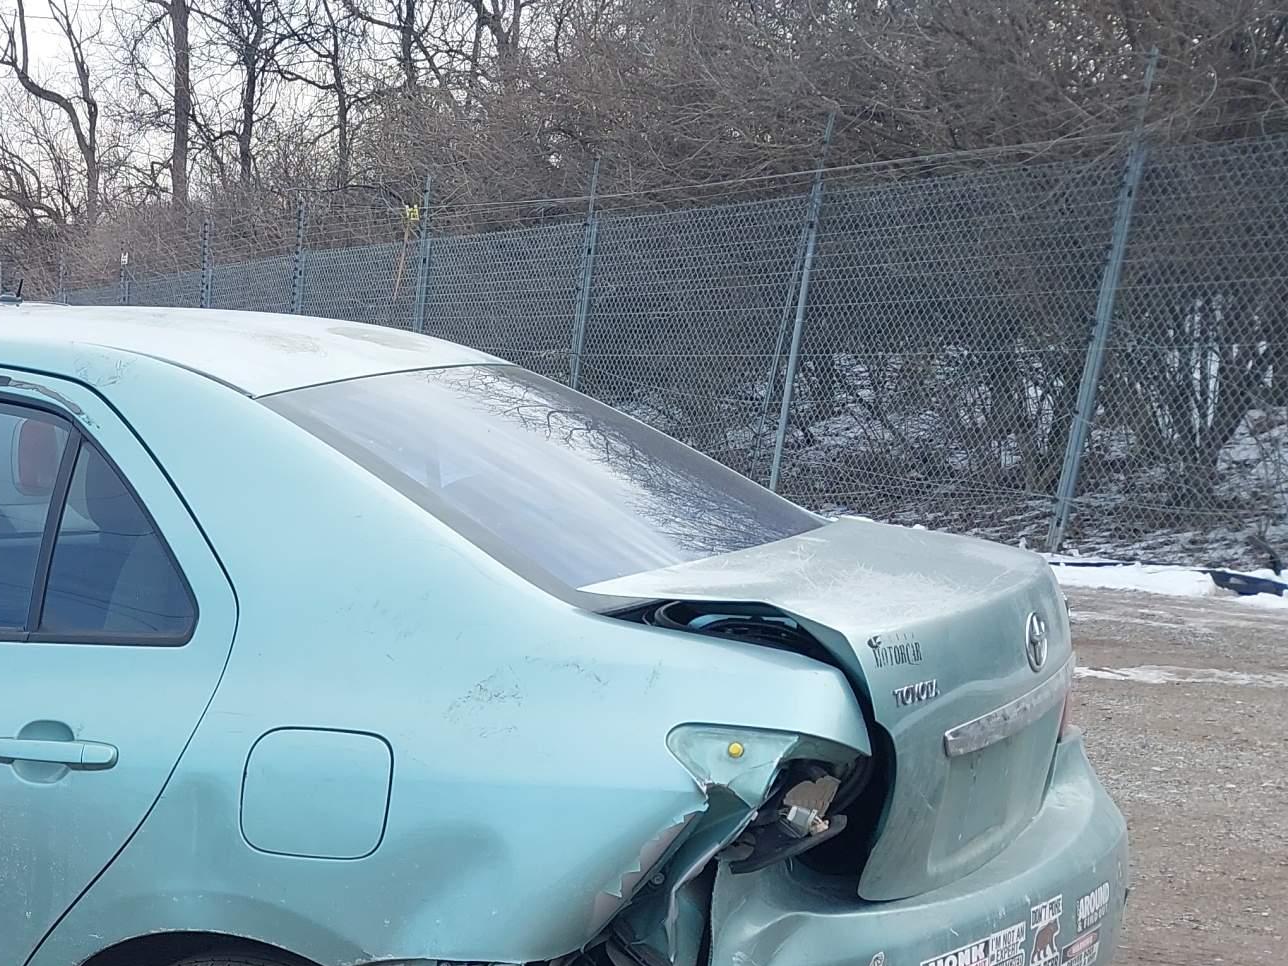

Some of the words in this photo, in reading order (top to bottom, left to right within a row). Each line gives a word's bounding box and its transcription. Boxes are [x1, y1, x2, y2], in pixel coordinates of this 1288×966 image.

[1079, 882, 1109, 920] AROUND
[1002, 929, 1015, 948] NOT
[996, 942, 1019, 962] EXPERT
